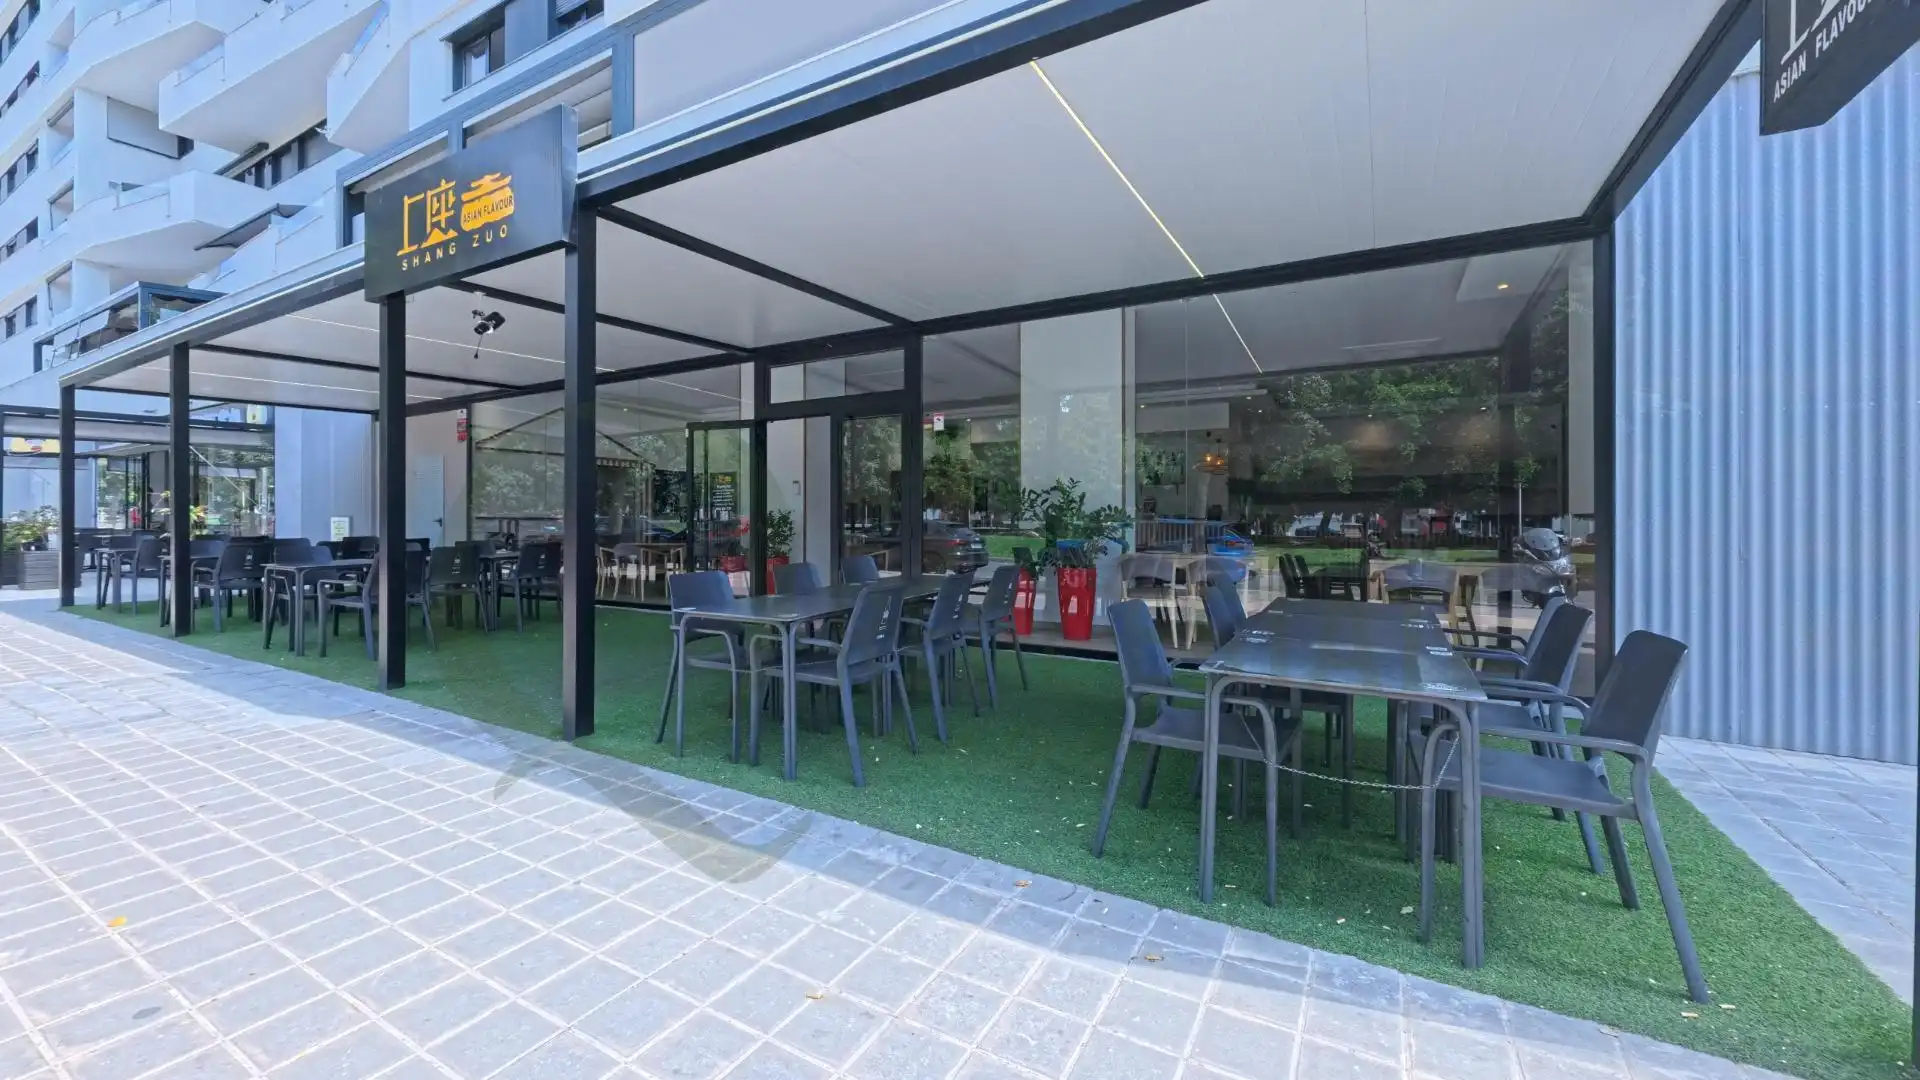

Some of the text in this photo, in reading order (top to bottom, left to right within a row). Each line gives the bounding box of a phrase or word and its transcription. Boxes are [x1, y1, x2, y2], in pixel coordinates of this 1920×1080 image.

[1773, 50, 1807, 103] ASIAN
[1815, 0, 1872, 58] FLAVOU
[463, 194, 514, 224] ASIAN FLAVOUR
[401, 224, 508, 271] SHANG ZUO
